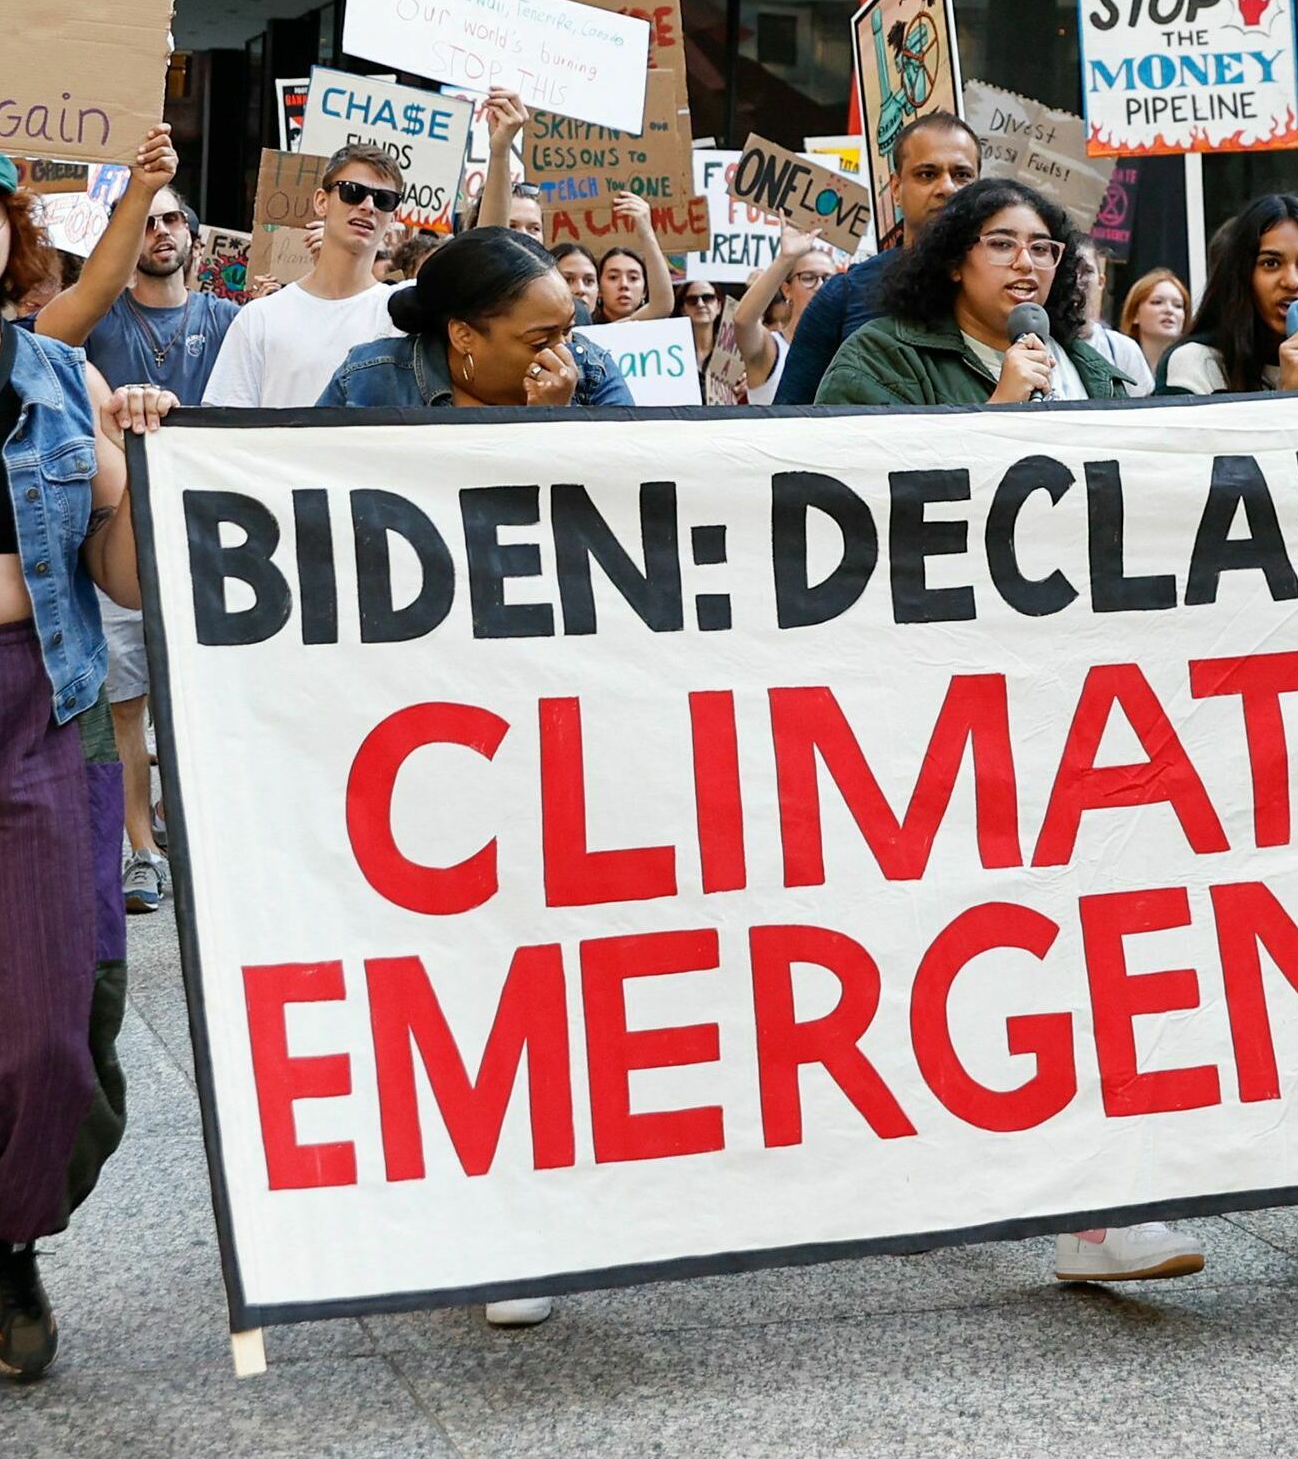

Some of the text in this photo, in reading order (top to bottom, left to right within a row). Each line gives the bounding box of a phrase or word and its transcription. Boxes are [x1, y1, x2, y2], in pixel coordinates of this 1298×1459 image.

[1162, 30, 1209, 47] THE
[540, 41, 598, 82] burning
[1089, 48, 1285, 94] MONEY
[516, 68, 568, 106] THIS
[1126, 91, 1258, 126] PIPELINE
[532, 144, 621, 171] LESSONS
[628, 152, 647, 164] TO
[539, 176, 599, 204] TEACH
[629, 176, 673, 198] ONE
[552, 196, 709, 243] A CHNCE
[182, 479, 731, 647] BIDEN:
